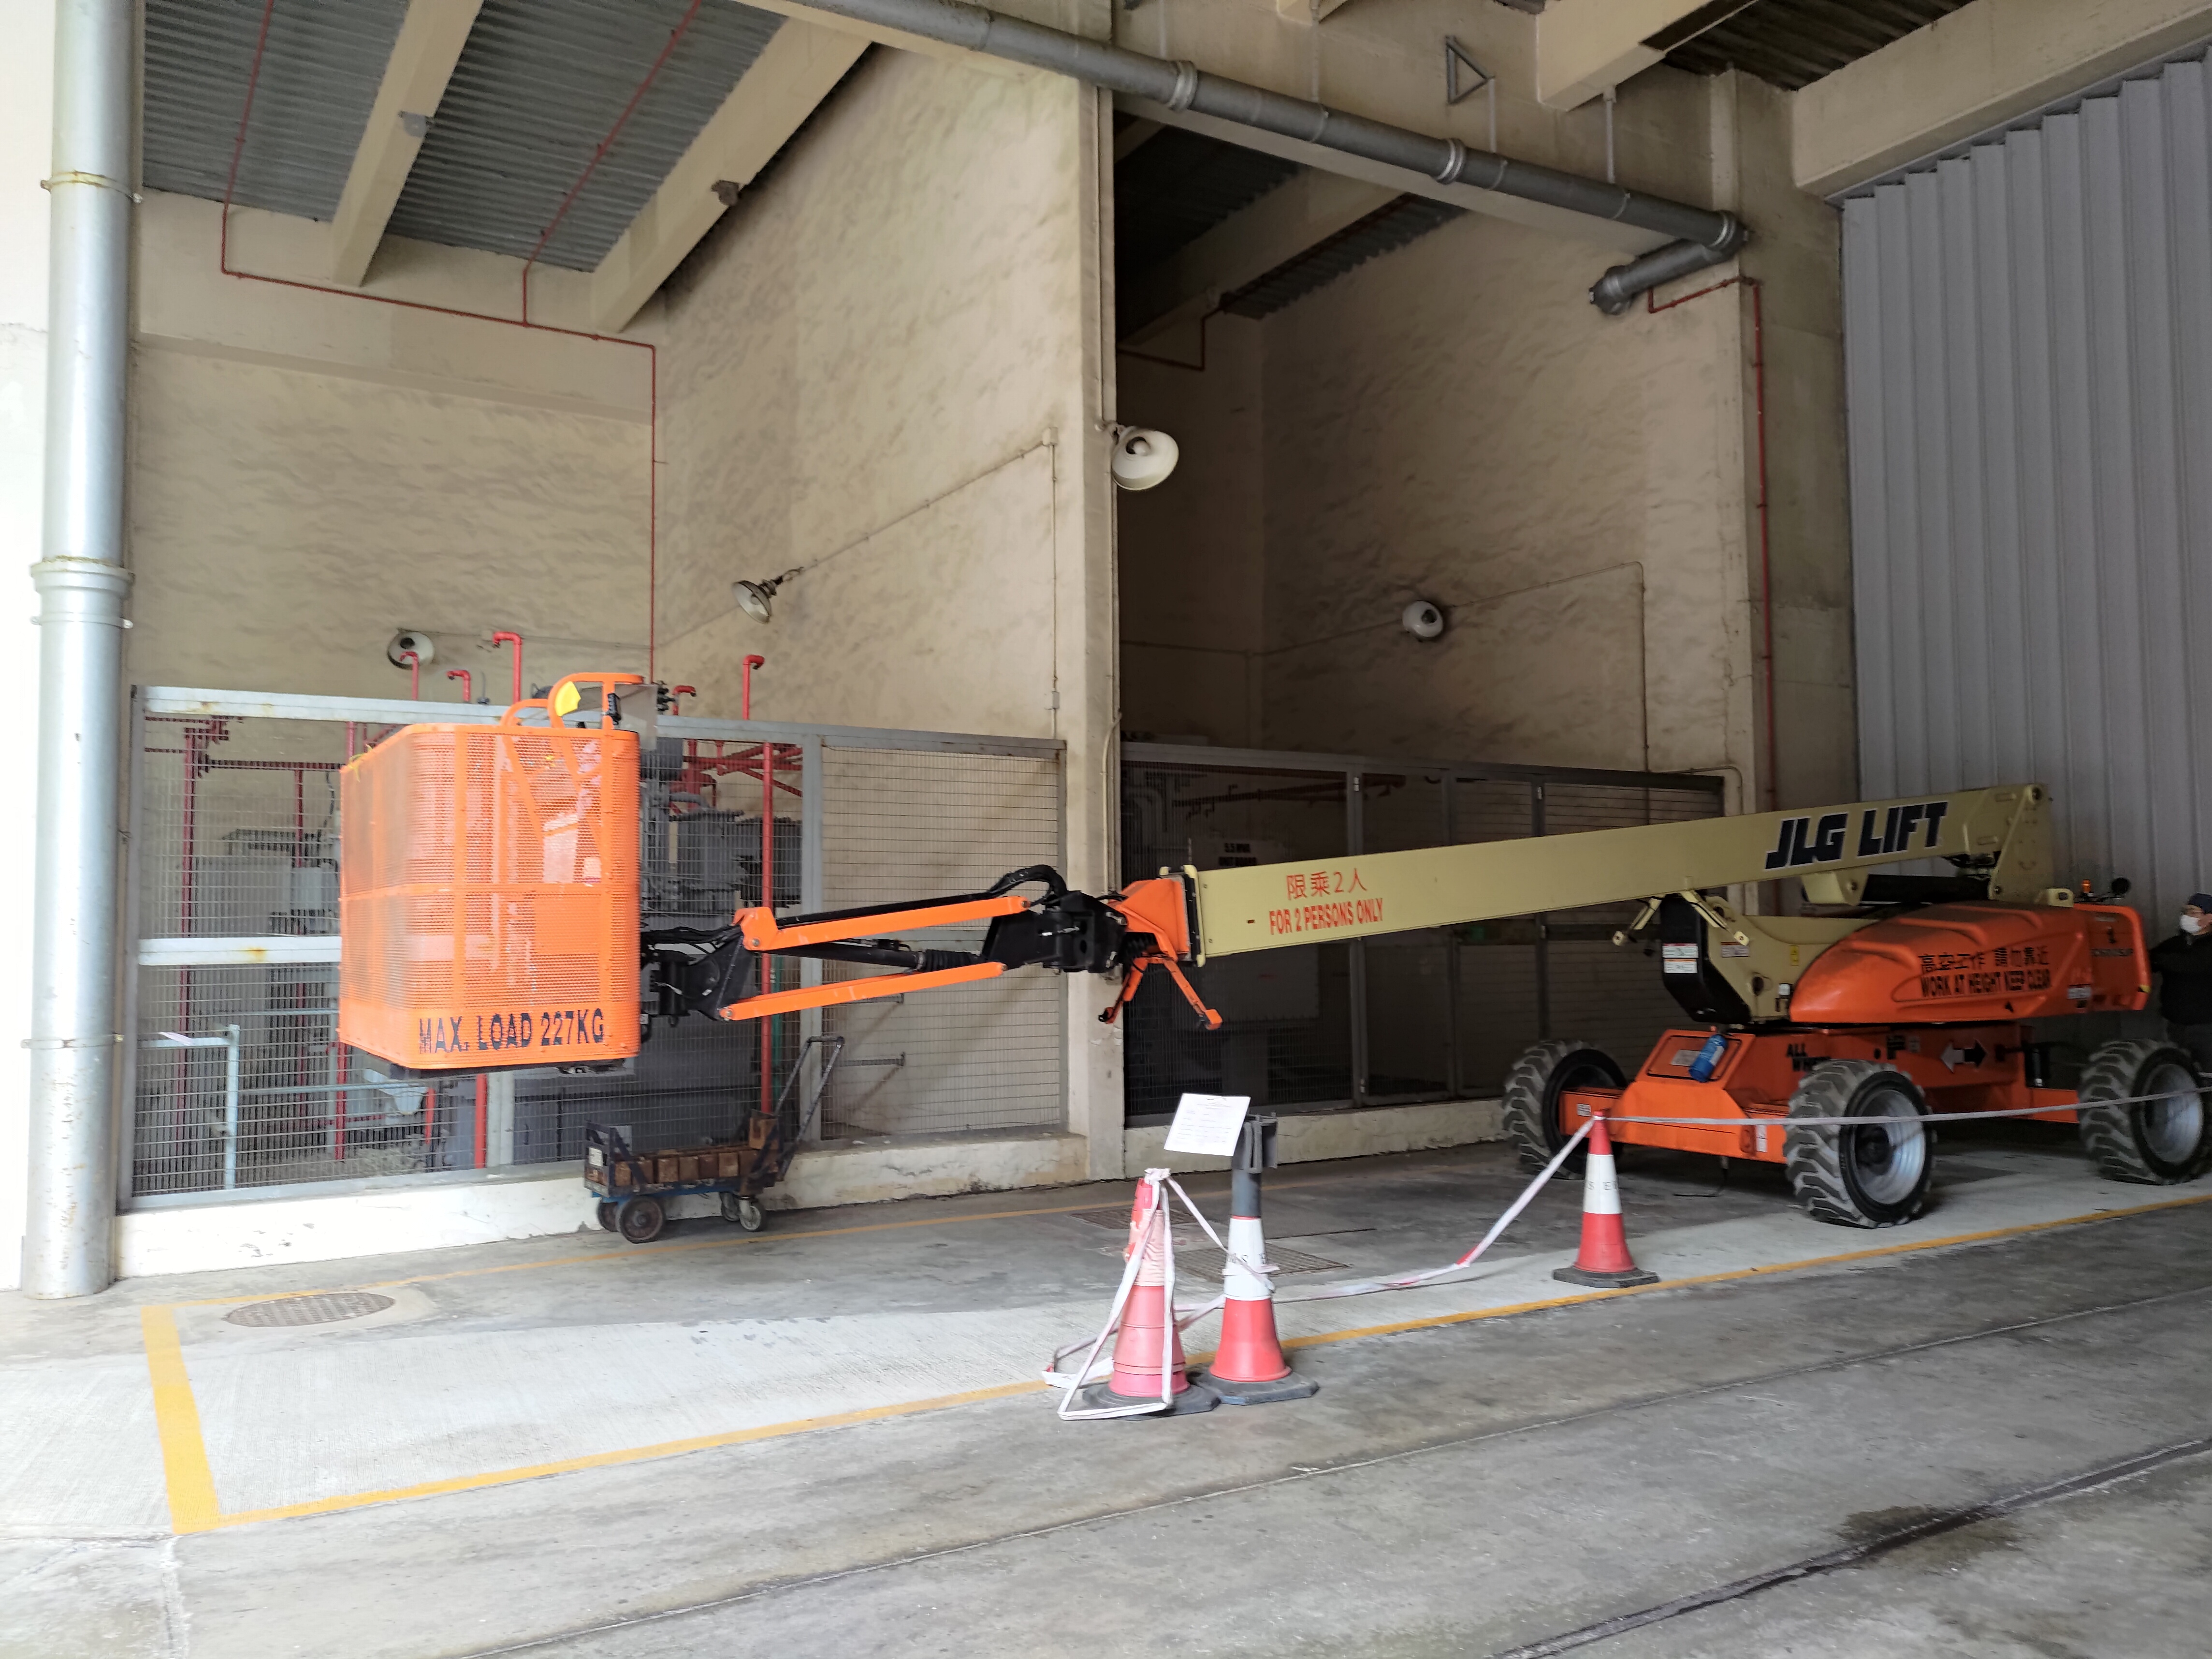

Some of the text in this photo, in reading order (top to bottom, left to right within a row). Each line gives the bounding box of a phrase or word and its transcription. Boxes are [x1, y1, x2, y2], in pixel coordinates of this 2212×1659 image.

[1765, 801, 1948, 870] JLG LIFT
[1286, 868, 1368, 901] 限乘2人
[1269, 898, 1383, 935] FOR 2 PERSONS ONLY
[419, 1008, 604, 1054] MAX. LOAD 227KG
